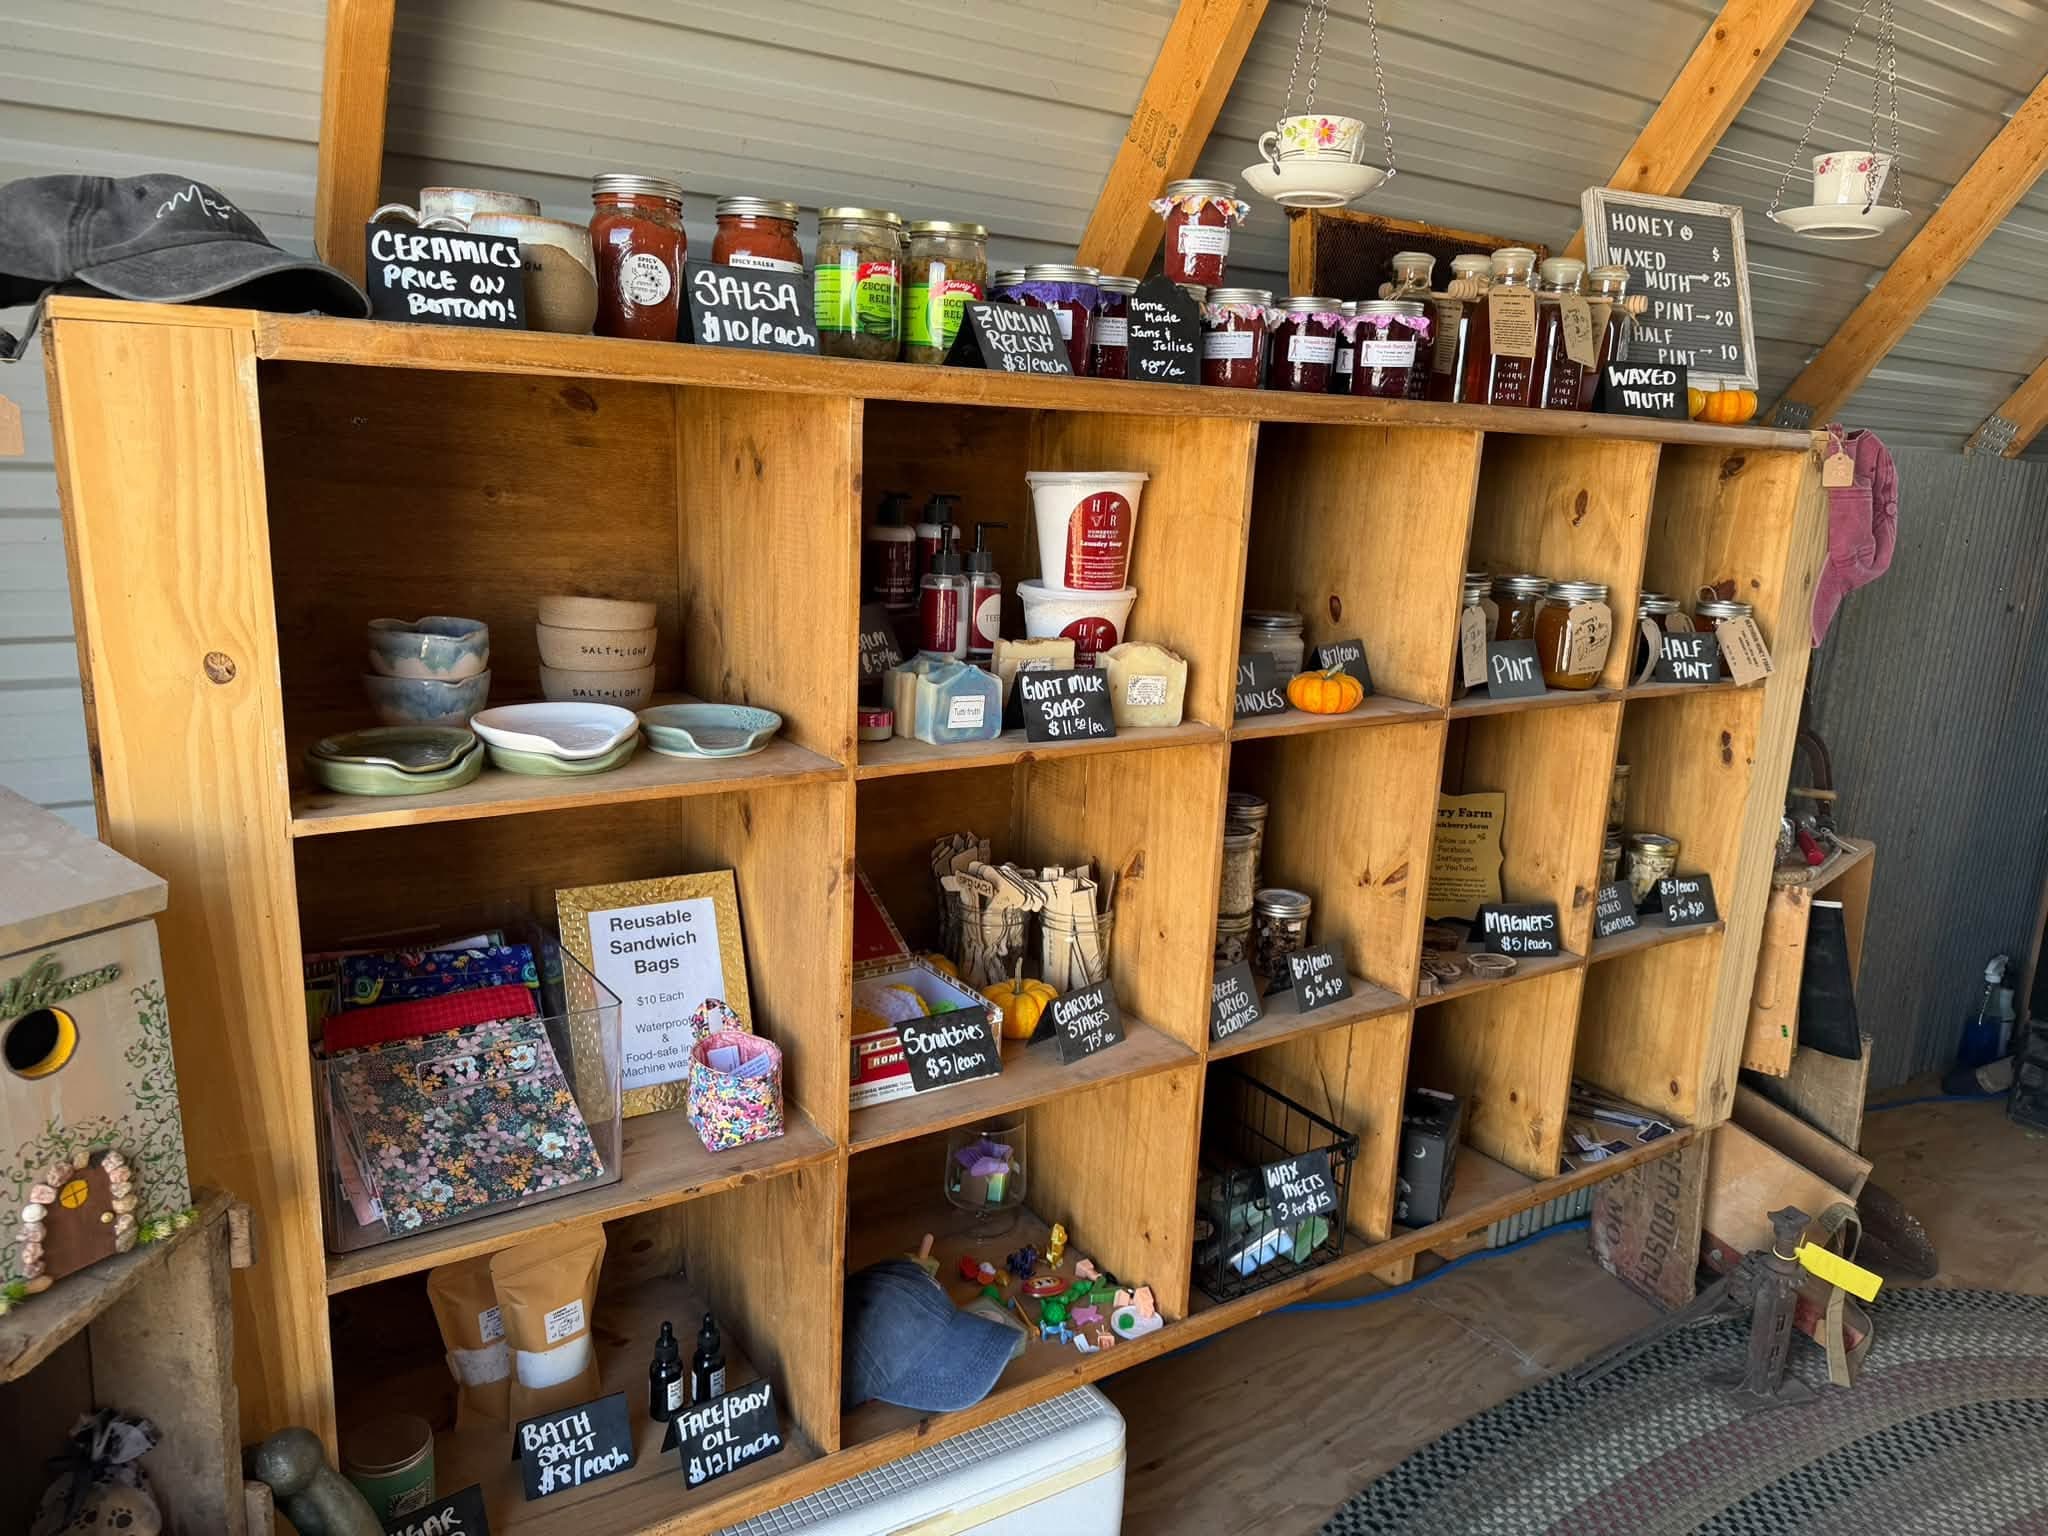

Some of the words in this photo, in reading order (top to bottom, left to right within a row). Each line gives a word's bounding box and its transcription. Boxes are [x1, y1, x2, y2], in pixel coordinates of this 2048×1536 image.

[1612, 213, 1673, 237] HONEY
[371, 230, 521, 268] CERAMICS
[1610, 247, 1666, 270] WAXED
[1712, 247, 1720, 262] $
[752, 259, 775, 269] SALSA
[383, 264, 457, 291] PRICE
[470, 275, 504, 295] ON
[1645, 270, 1690, 293] MUTH
[1714, 271, 1730, 288] 25
[694, 270, 800, 316] SALSA
[1131, 298, 1166, 311] Home
[407, 293, 517, 322] BOTTOM!
[1145, 311, 1181, 323] Made
[1655, 301, 1694, 322] PINT
[1716, 311, 1733, 327] 20
[973, 304, 1051, 336] ZUCCINI
[1131, 325, 1160, 338] Jams
[986, 329, 1054, 355] RELISH
[1153, 338, 1194, 353] Jellies
[1633, 325, 1673, 345] HALF
[1001, 354, 1068, 374] $8/each
[1658, 348, 1696, 367] PINT
[1720, 345, 1738, 361] 10
[1608, 366, 1676, 387] WAXED
[1623, 390, 1674, 410] MUTH
[860, 632, 888, 650] ALM
[1660, 638, 1702, 661] HALF
[1237, 661, 1257, 687] OY
[1492, 655, 1534, 684] PINT
[1673, 661, 1712, 681] PINT
[1022, 675, 1062, 702] GOAT
[1068, 672, 1105, 693] MILK
[1042, 699, 1085, 721] SOAP
[1235, 688, 1285, 713] ANDLES
[1458, 808, 1493, 818] Farm
[609, 909, 692, 933] Reusable
[1485, 912, 1553, 934] MAGNETS
[610, 930, 697, 956] Sandwich
[1501, 936, 1552, 952] $5/each
[634, 956, 680, 976] Bags
[636, 994, 656, 1006] $10
[659, 990, 685, 1004] Each
[1212, 976, 1239, 1003] REEZE
[1053, 989, 1103, 1026] GARDEN
[1219, 992, 1249, 1020] DRIED
[635, 1015, 693, 1034] Waterproof
[1067, 1010, 1110, 1039] STAKES
[1216, 1005, 1258, 1038] GOODIES
[662, 1033, 670, 1043] &
[903, 1022, 984, 1055] Scrubbies
[626, 1046, 678, 1063] Food-safe
[681, 1044, 692, 1053] lin
[622, 1063, 665, 1078] Machine
[668, 1059, 688, 1068] was
[926, 1052, 986, 1080] $5/each
[1267, 1161, 1300, 1189] WAX
[1282, 1173, 1325, 1200] MELTS
[1276, 1203, 1289, 1221] 3
[1636, 1150, 1682, 1284] SER-BUSCH
[677, 1384, 771, 1442] FACE/BODY
[521, 1411, 591, 1452] BATH
[702, 1429, 741, 1451] OIL
[537, 1432, 597, 1466] SALT
[688, 1432, 780, 1485] $12/each
[537, 1445, 630, 1498] $8/each
[389, 1506, 462, 1536] GAR
